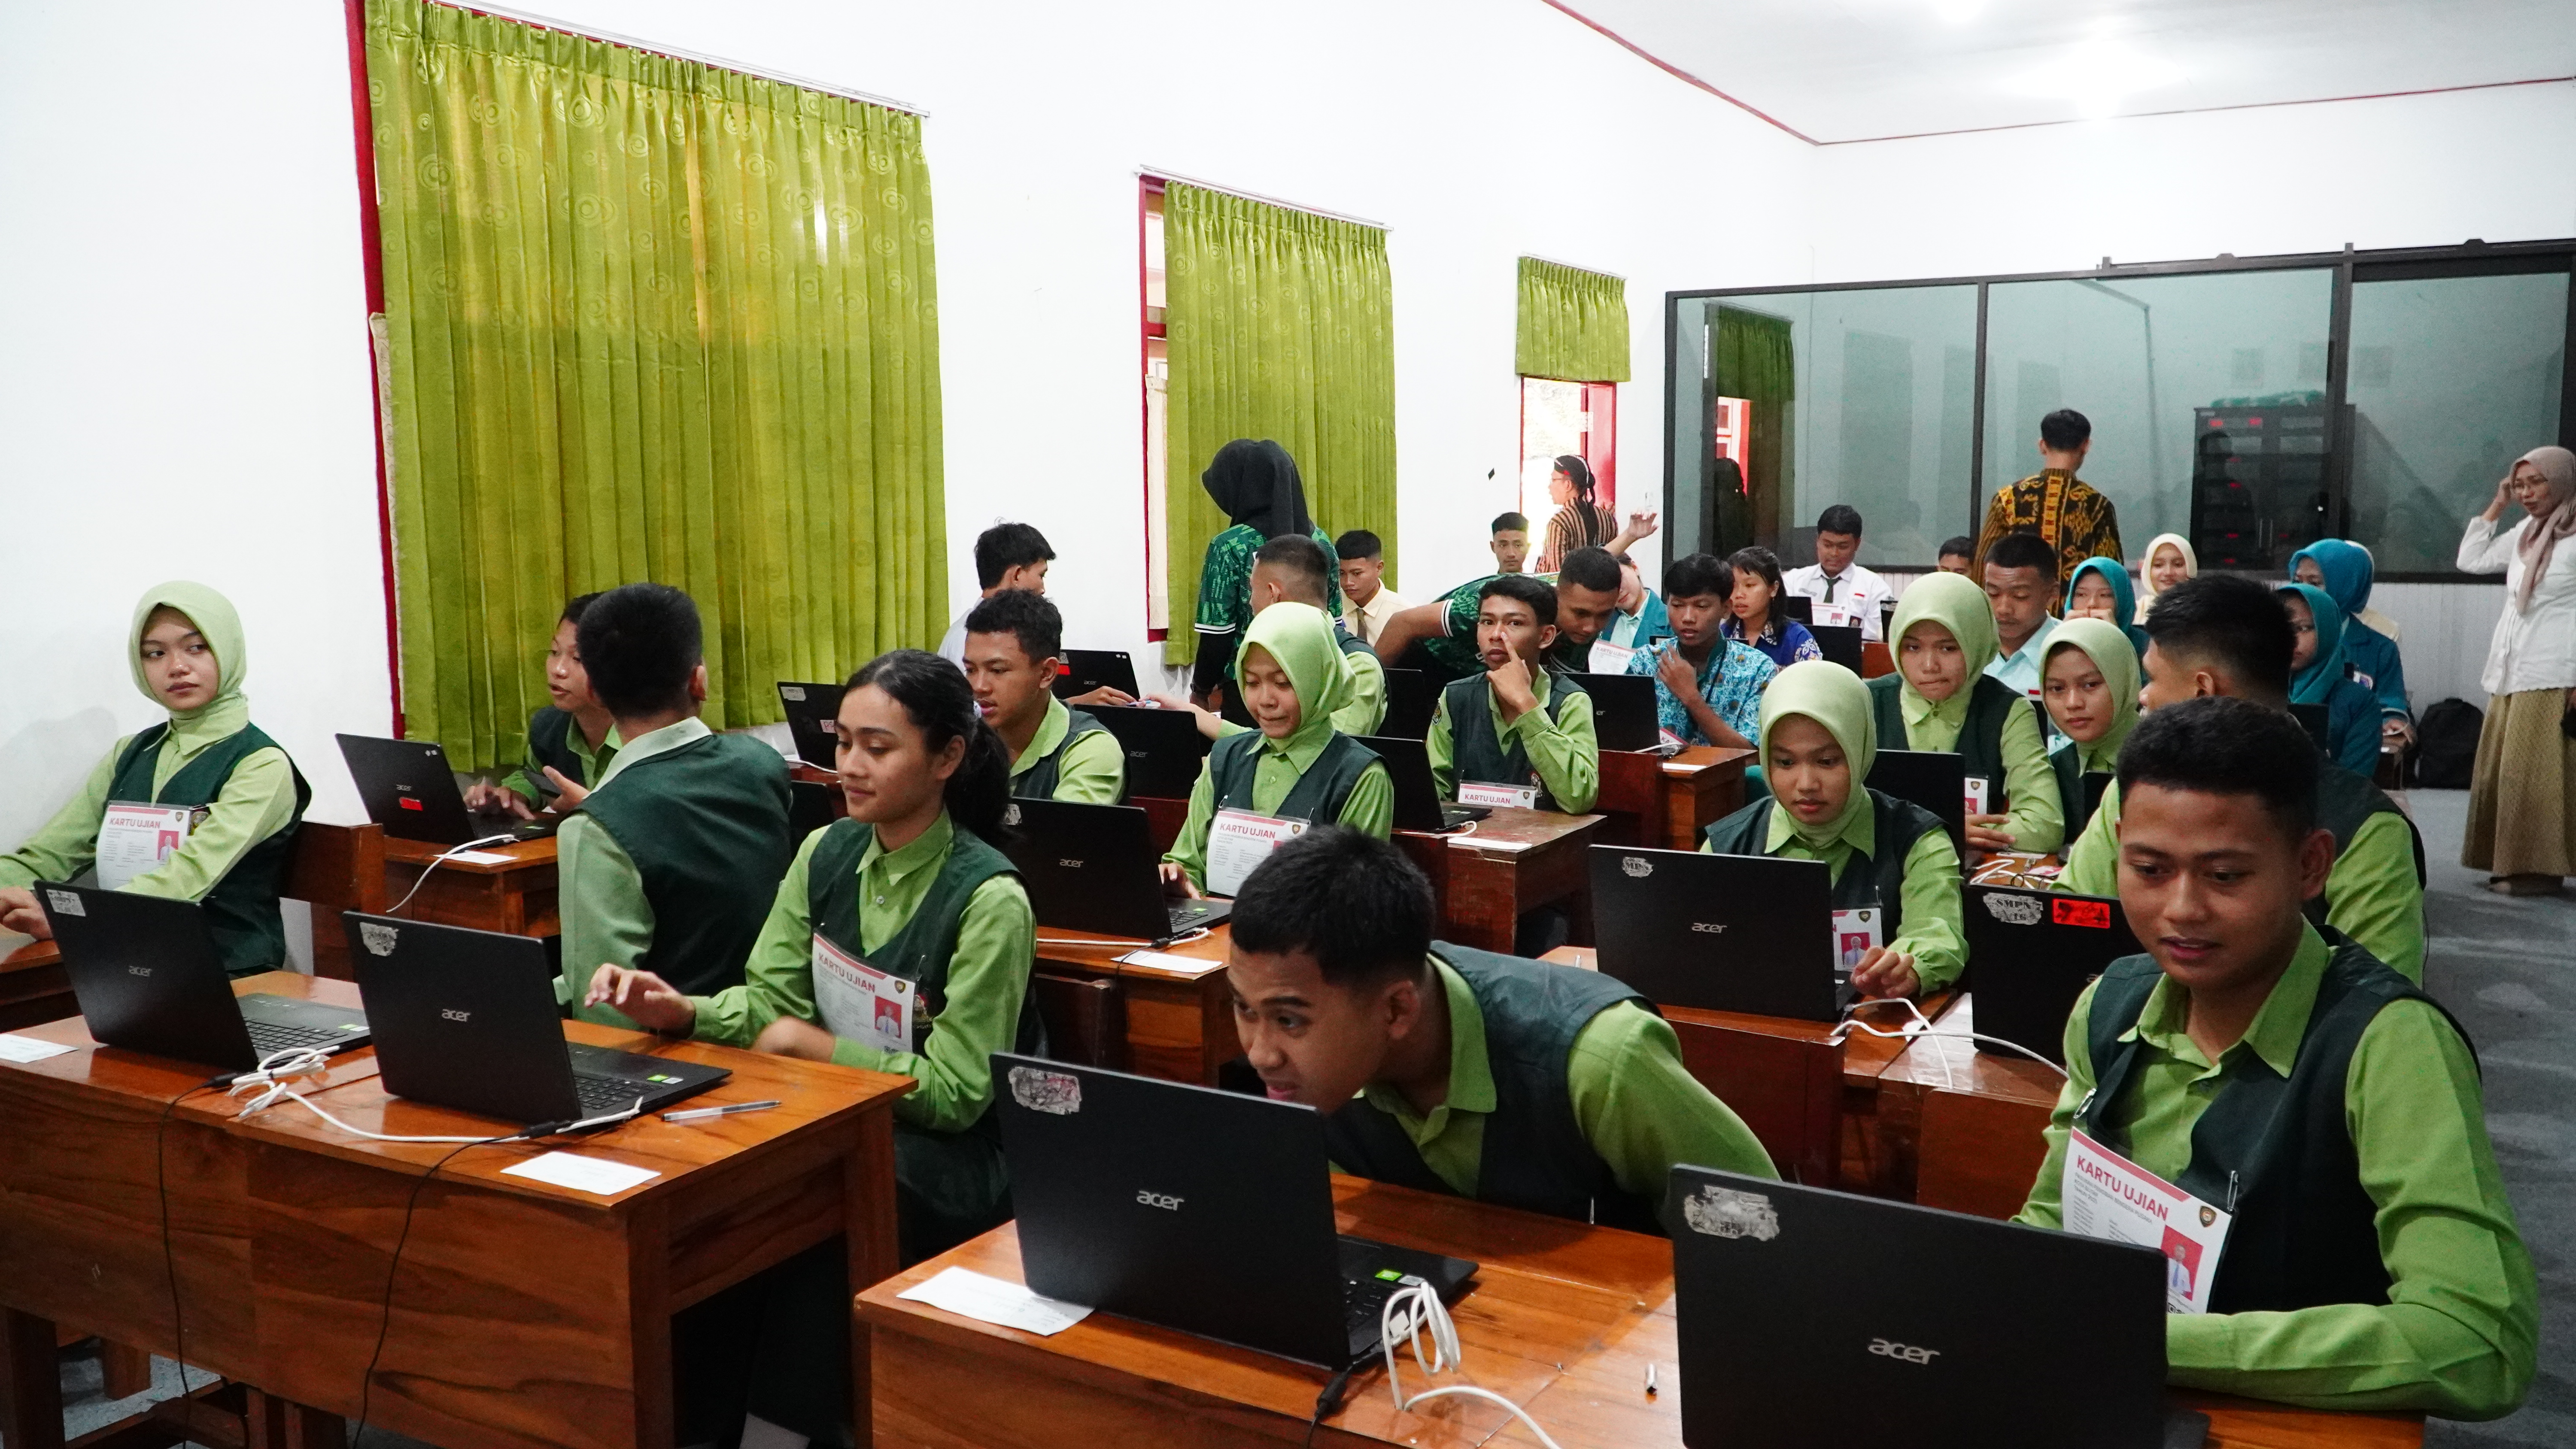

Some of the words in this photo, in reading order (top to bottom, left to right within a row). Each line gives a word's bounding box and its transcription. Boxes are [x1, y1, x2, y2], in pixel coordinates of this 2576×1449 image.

[1596, 646, 1613, 655] KARTU
[1130, 750, 1148, 758] acer
[1464, 794, 1488, 802] KARTU
[109, 817, 136, 827] KARTU
[137, 820, 161, 829] UJIAN
[1220, 823, 1249, 834] KARTU
[1250, 828, 1276, 839] UJIAN
[1059, 858, 1084, 868] acer
[1692, 922, 1727, 934] acer
[128, 965, 152, 977] acer
[818, 952, 844, 977] KARTU
[846, 972, 875, 993] UJIAN
[441, 1009, 471, 1022] acer
[2076, 1155, 2121, 1193] KARTU
[2123, 1184, 2169, 1222] UJIAN
[1136, 1190, 1185, 1211] acer
[1868, 1337, 1941, 1365] acer
